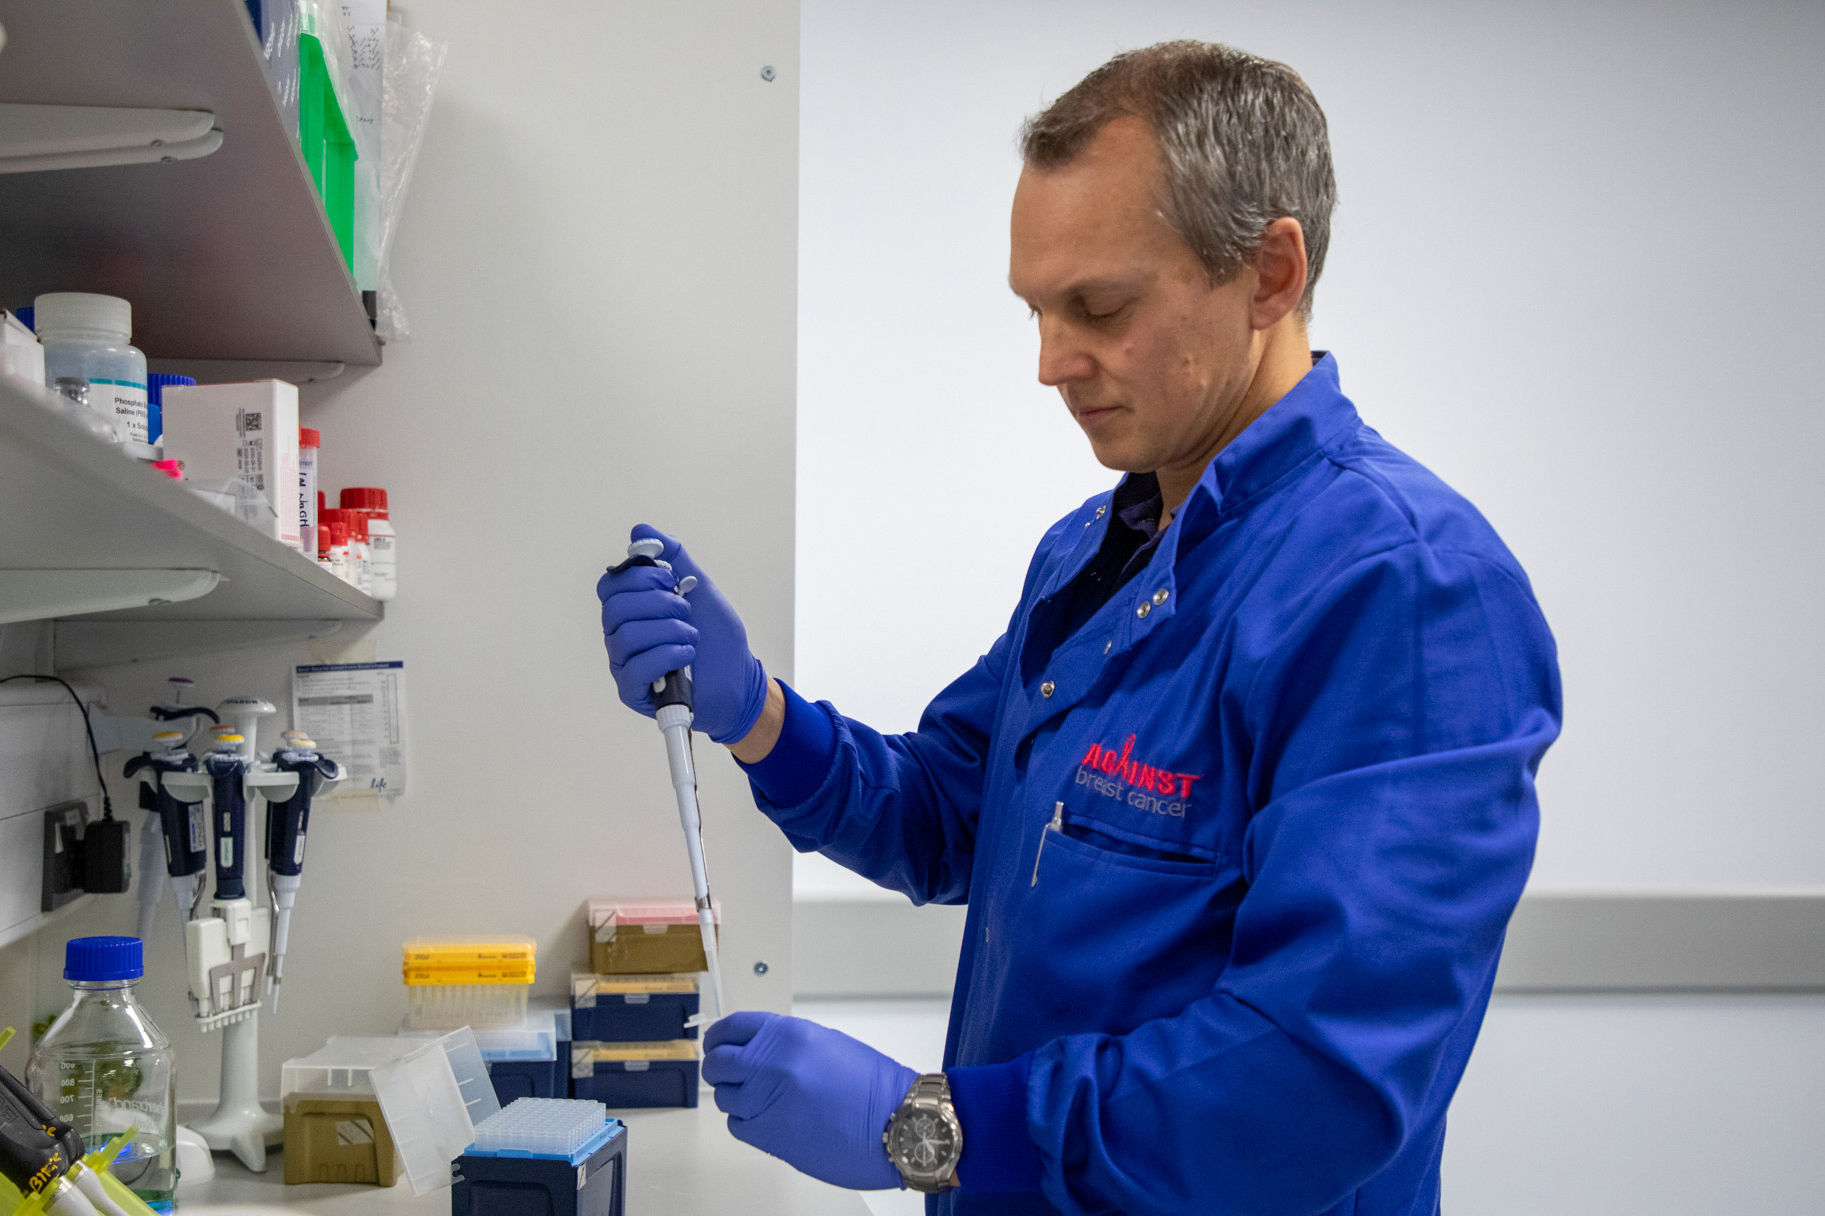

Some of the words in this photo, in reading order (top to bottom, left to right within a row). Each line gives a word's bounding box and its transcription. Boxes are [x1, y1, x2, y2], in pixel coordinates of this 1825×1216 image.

[115, 407, 135, 416] Saline
[1082, 733, 1200, 798] AGAINST
[371, 777, 387, 793] life
[1076, 765, 1123, 801] breast
[1127, 790, 1193, 818] cancer
